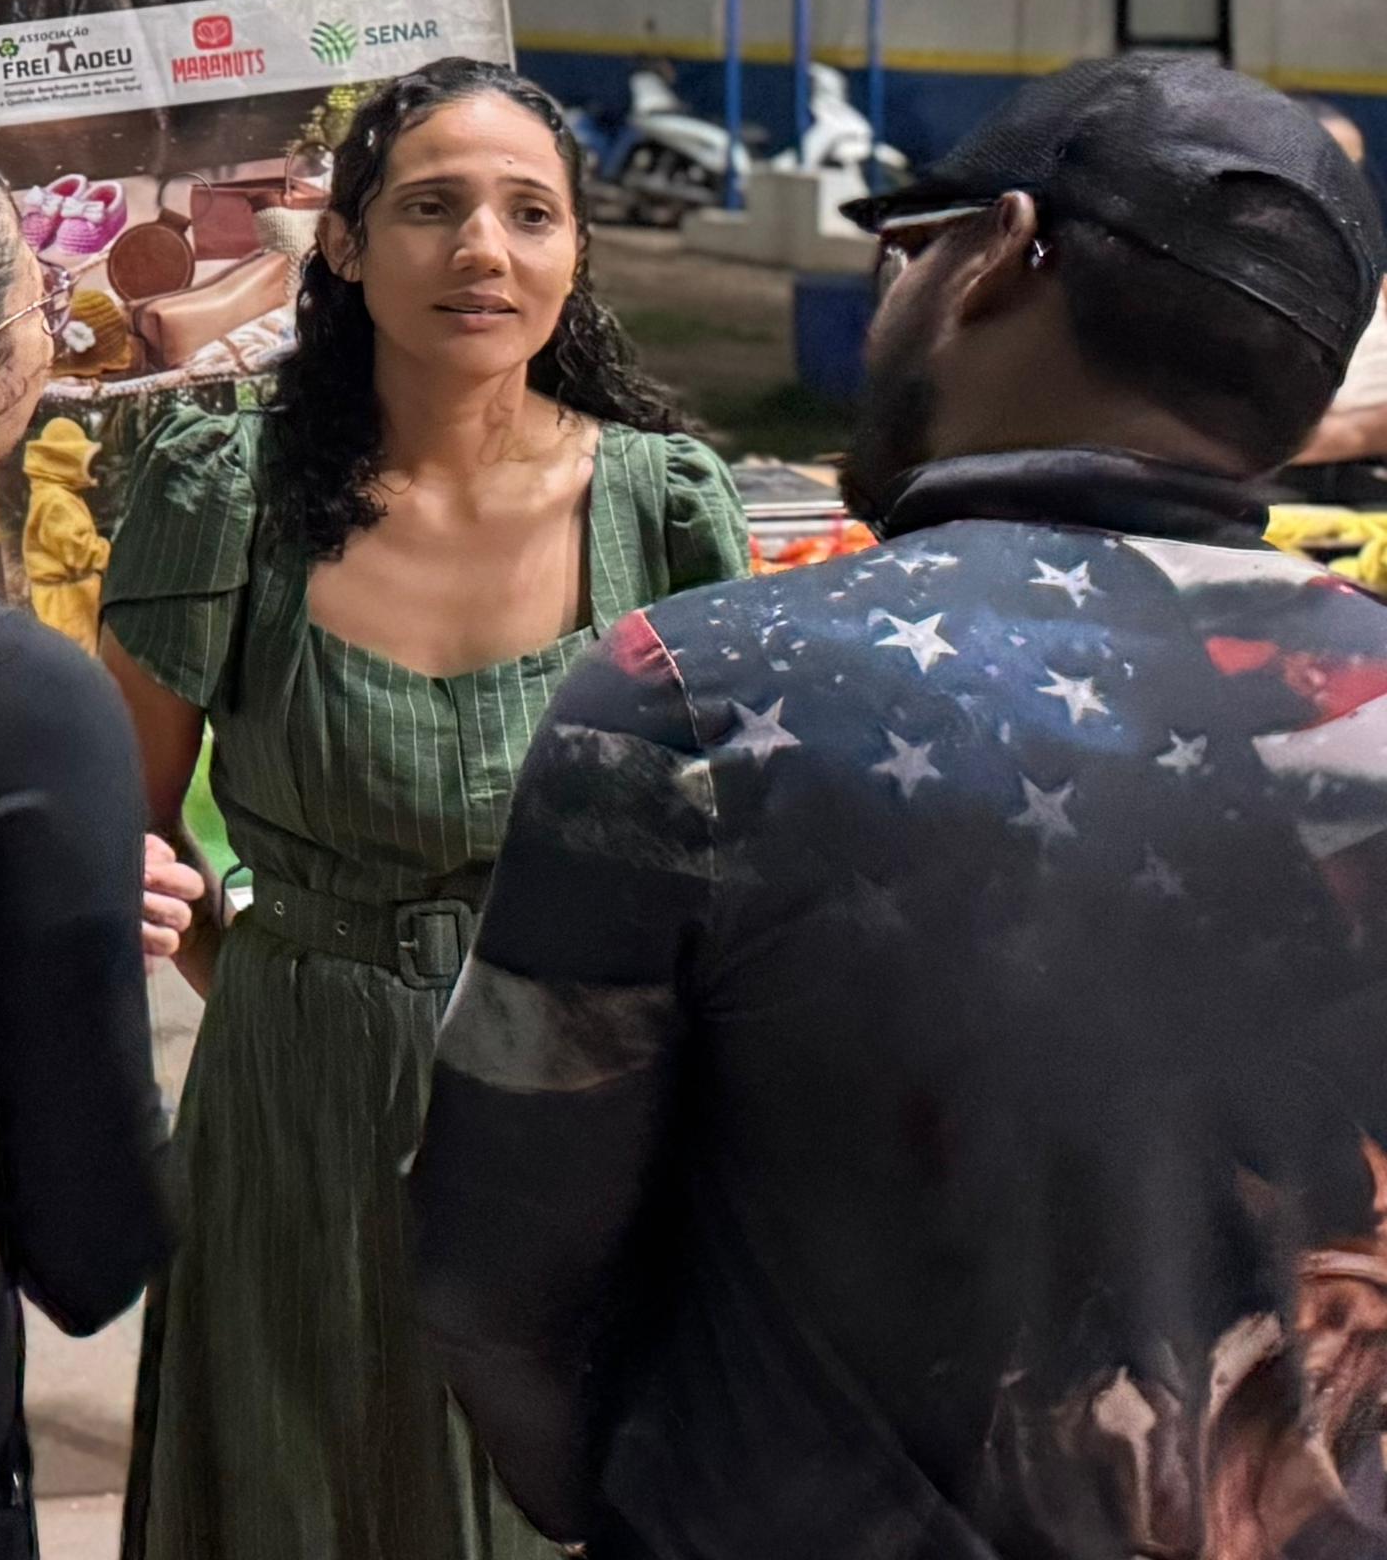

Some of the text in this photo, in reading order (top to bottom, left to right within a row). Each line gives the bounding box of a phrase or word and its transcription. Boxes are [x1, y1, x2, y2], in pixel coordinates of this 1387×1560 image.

[19, 27, 90, 44] ASSOCIAÇÃO
[364, 20, 439, 46] SENAR
[2, 40, 133, 80] FREI TADEU
[171, 49, 266, 83] MARANUTS
